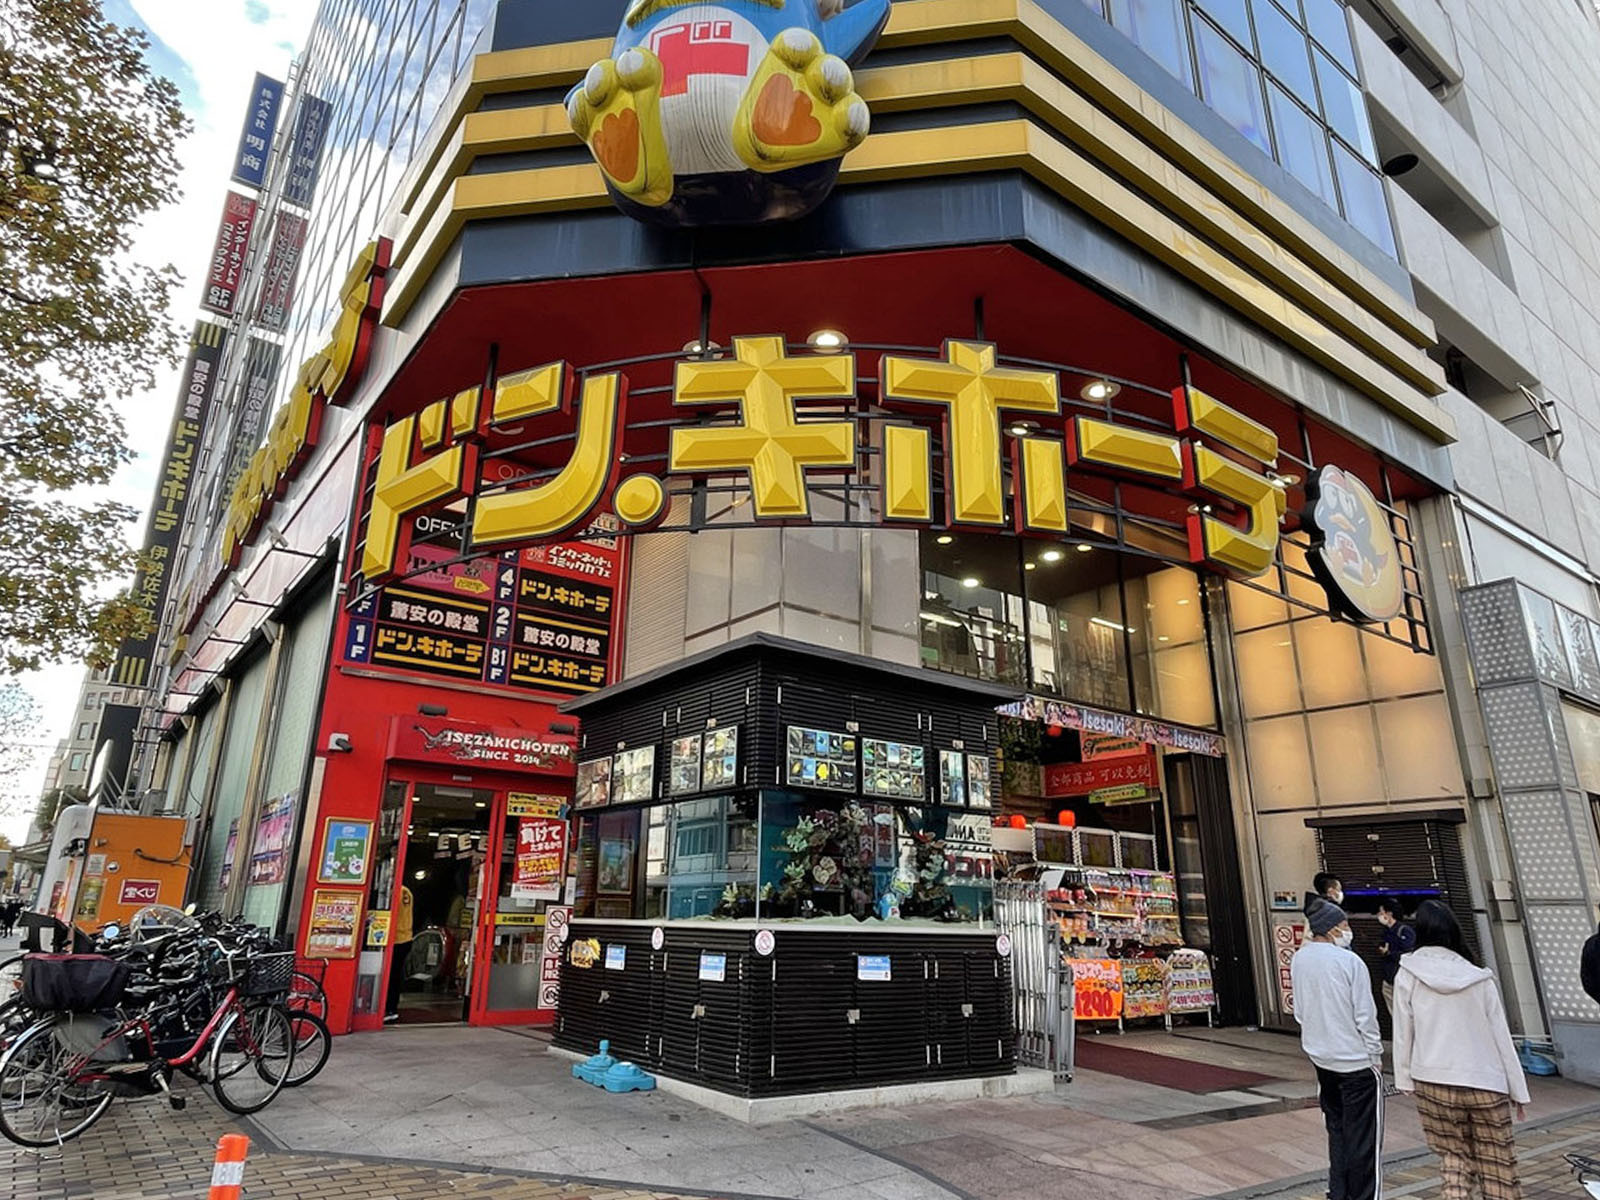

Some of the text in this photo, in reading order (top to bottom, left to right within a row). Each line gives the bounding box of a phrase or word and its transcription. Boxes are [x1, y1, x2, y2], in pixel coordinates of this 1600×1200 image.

[255, 88, 273, 130] 株式会社
[210, 286, 231, 299] 6F
[390, 601, 480, 633] 驚安の殿堂
[523, 626, 600, 656] 驚安の殿堂
[1083, 714, 1126, 738] Isesaki
[446, 732, 571, 757] ISEZAKICHOTEN
[1173, 729, 1211, 753] Isesaki
[473, 748, 541, 766] SINCE 2014
[520, 825, 562, 846] 負けて
[123, 886, 156, 899] 宝くじ
